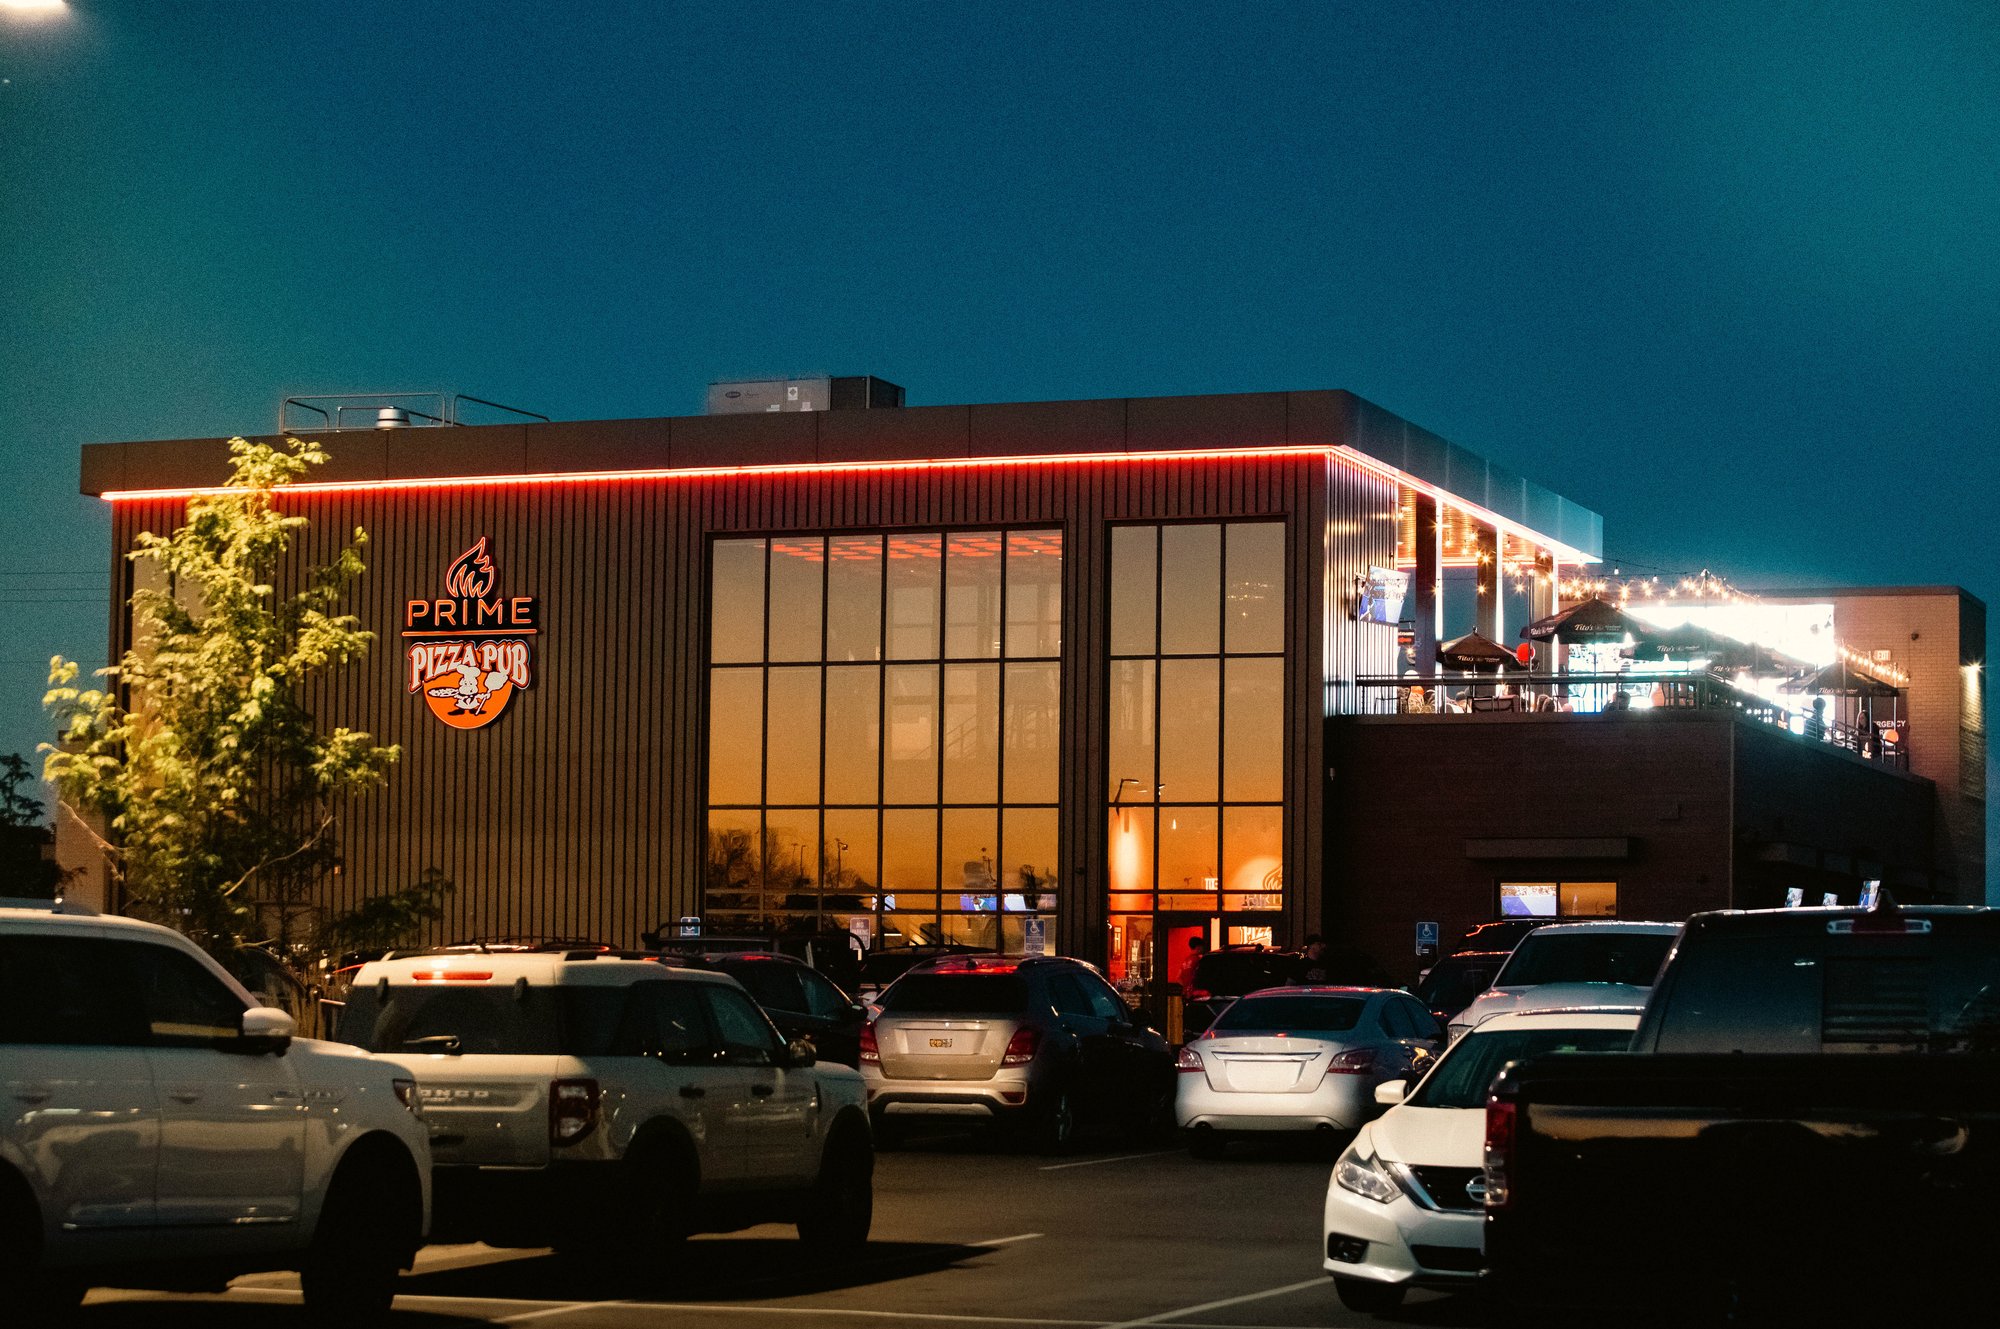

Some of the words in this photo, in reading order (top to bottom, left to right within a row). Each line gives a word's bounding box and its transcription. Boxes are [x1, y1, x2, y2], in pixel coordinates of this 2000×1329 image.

[408, 597, 532, 627] PRIME
[409, 643, 478, 691] PIZZA
[479, 641, 530, 687] PUB
